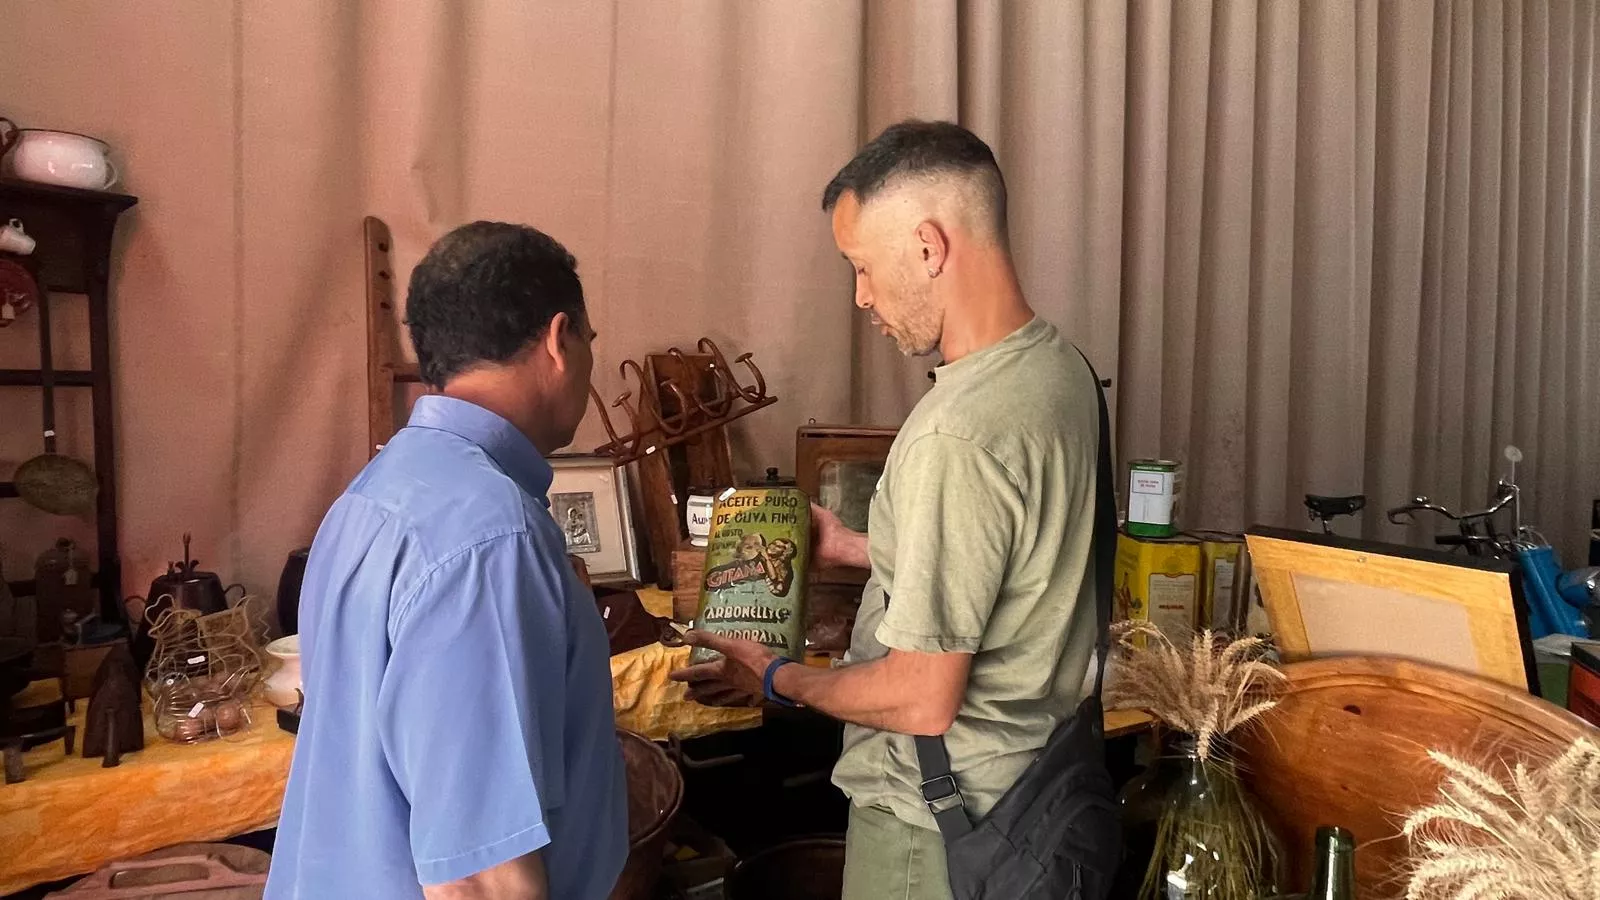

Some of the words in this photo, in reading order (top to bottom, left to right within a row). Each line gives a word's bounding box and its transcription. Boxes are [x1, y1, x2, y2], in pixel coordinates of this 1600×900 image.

[719, 496, 758, 508] ACEITE
[765, 497, 797, 508] PURO
[716, 514, 729, 525] DE
[735, 513, 767, 524] OLIVA
[772, 513, 797, 524] FINO
[706, 562, 766, 588] GITANA
[713, 629, 767, 643] ORDOBA
